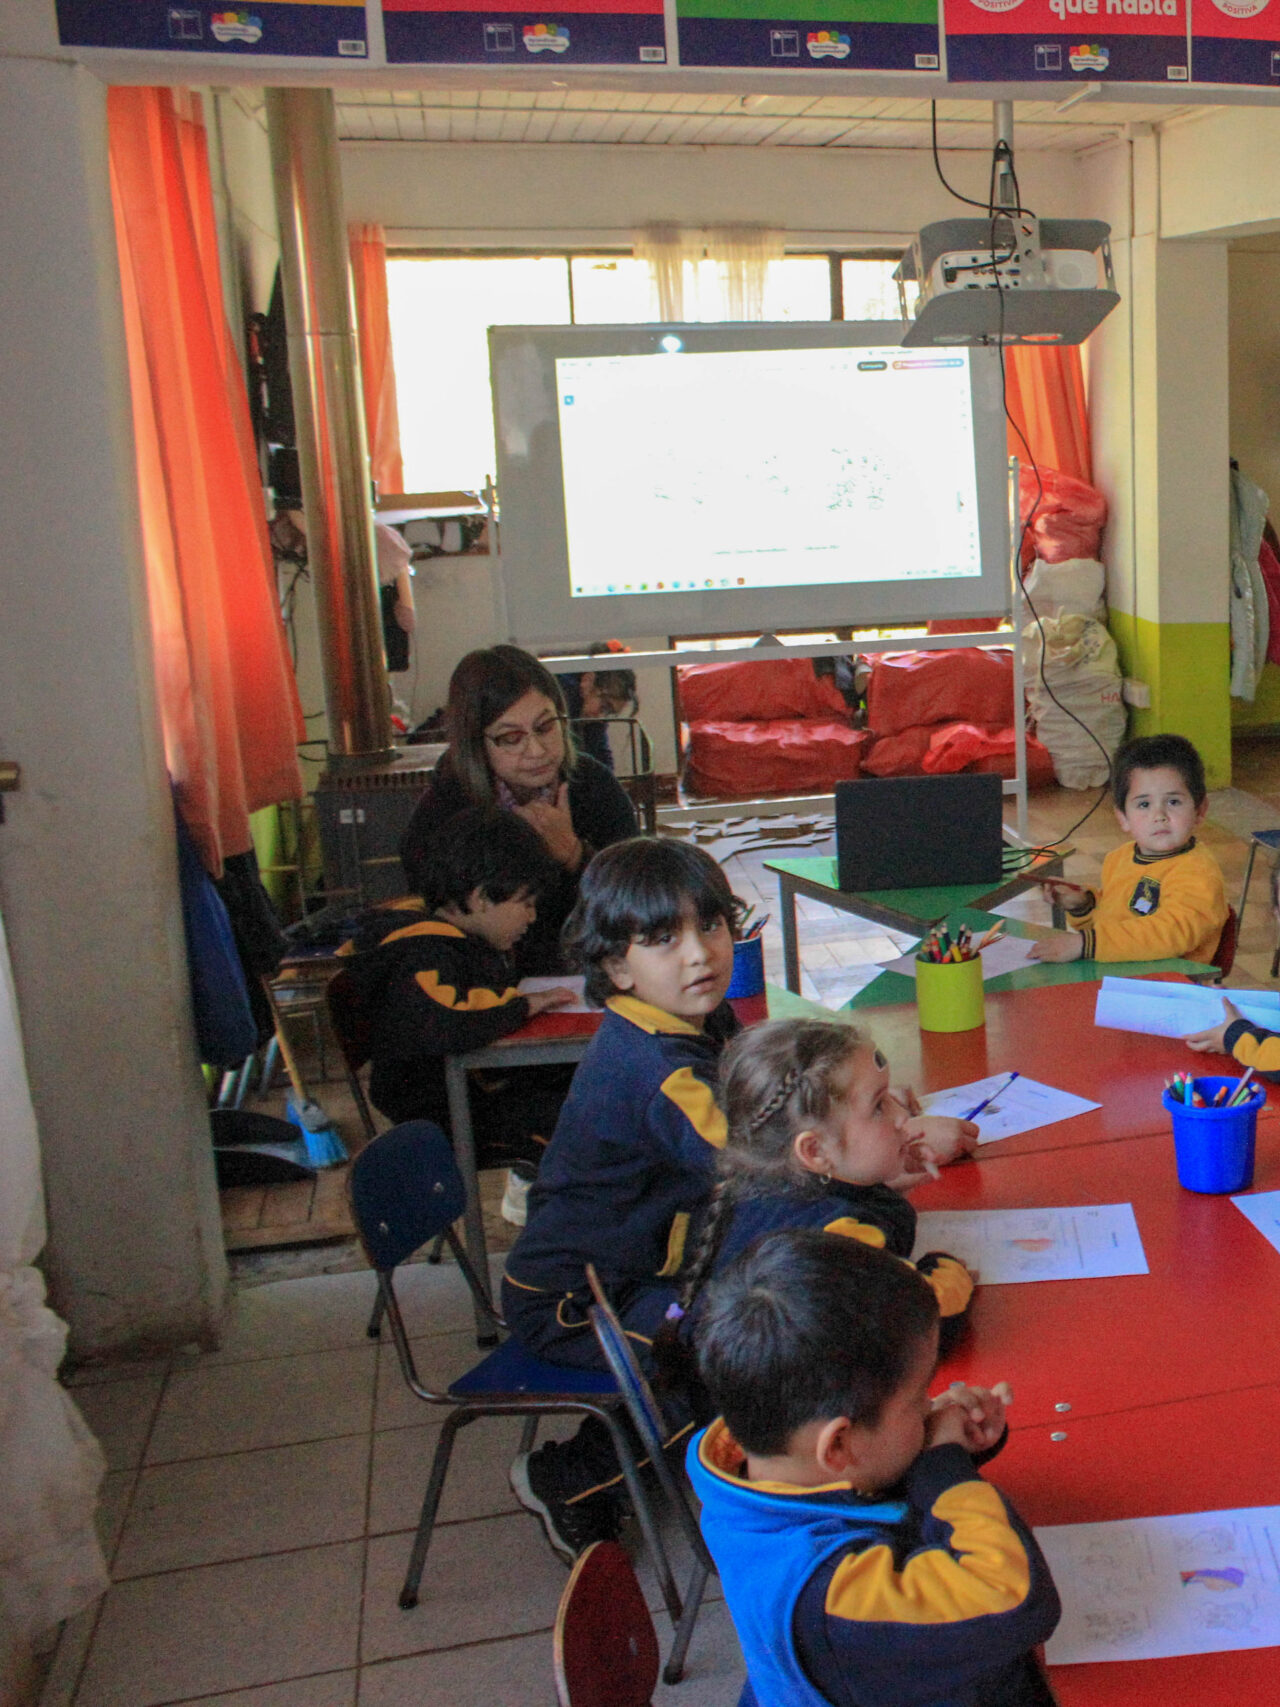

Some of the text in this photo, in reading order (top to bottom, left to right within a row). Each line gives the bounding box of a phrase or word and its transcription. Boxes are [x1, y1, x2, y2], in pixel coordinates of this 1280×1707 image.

[1049, 0, 1177, 20] que habla
[1222, 2, 1258, 15] POSITIVA
